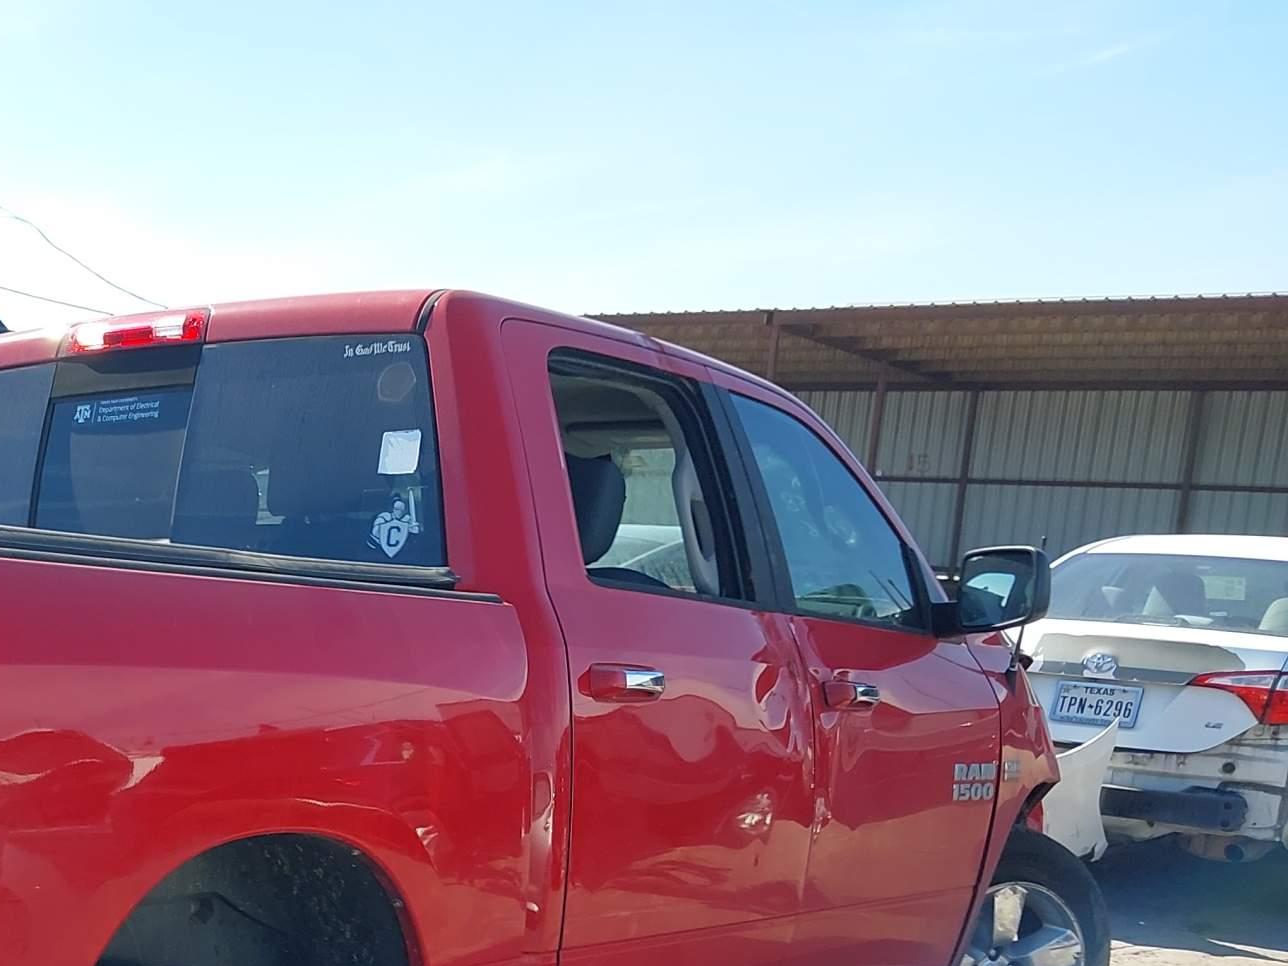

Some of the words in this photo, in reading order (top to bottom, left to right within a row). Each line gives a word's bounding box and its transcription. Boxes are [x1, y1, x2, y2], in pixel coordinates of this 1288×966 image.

[343, 344, 354, 358] In
[387, 340, 411, 352] Trust
[98, 405, 129, 414] Department
[387, 525, 401, 547] C
[1083, 686, 1116, 696] TEXAS
[953, 763, 997, 781] RAM
[952, 783, 994, 801] 1500
